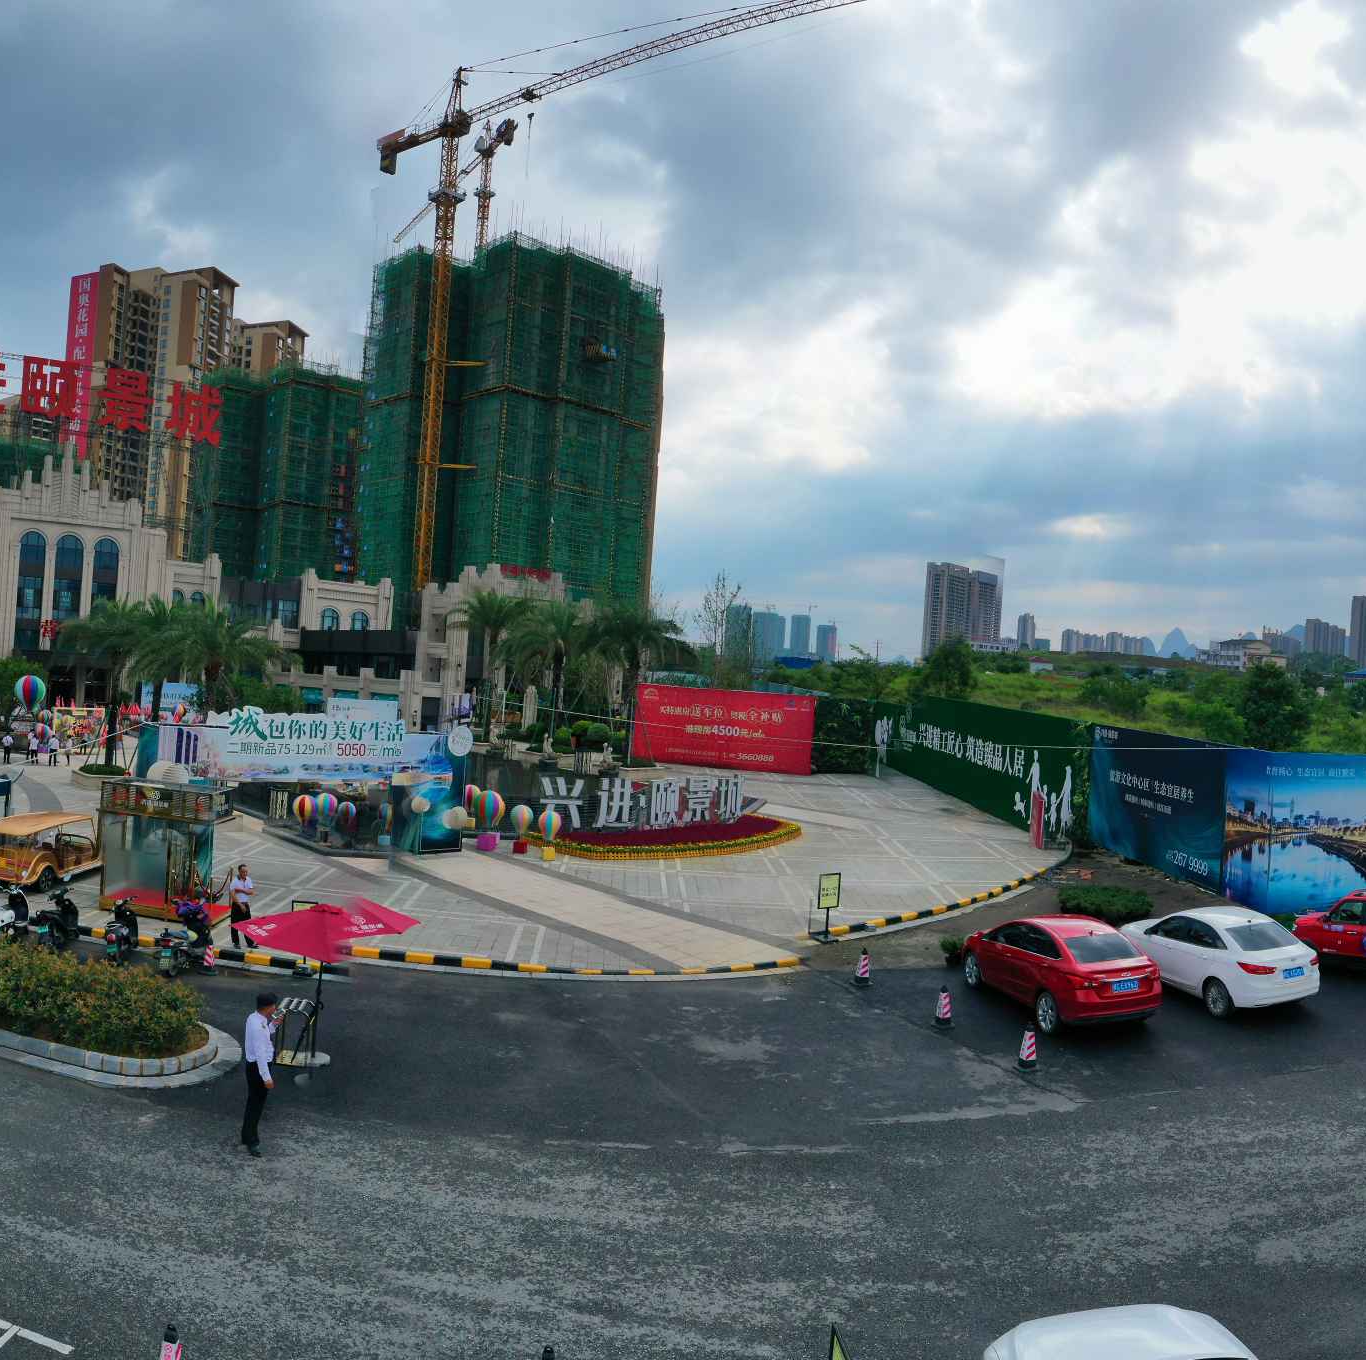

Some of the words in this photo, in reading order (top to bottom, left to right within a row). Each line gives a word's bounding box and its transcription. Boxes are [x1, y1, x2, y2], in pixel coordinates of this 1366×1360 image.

[228, 708, 403, 741] 城包你的美好生活
